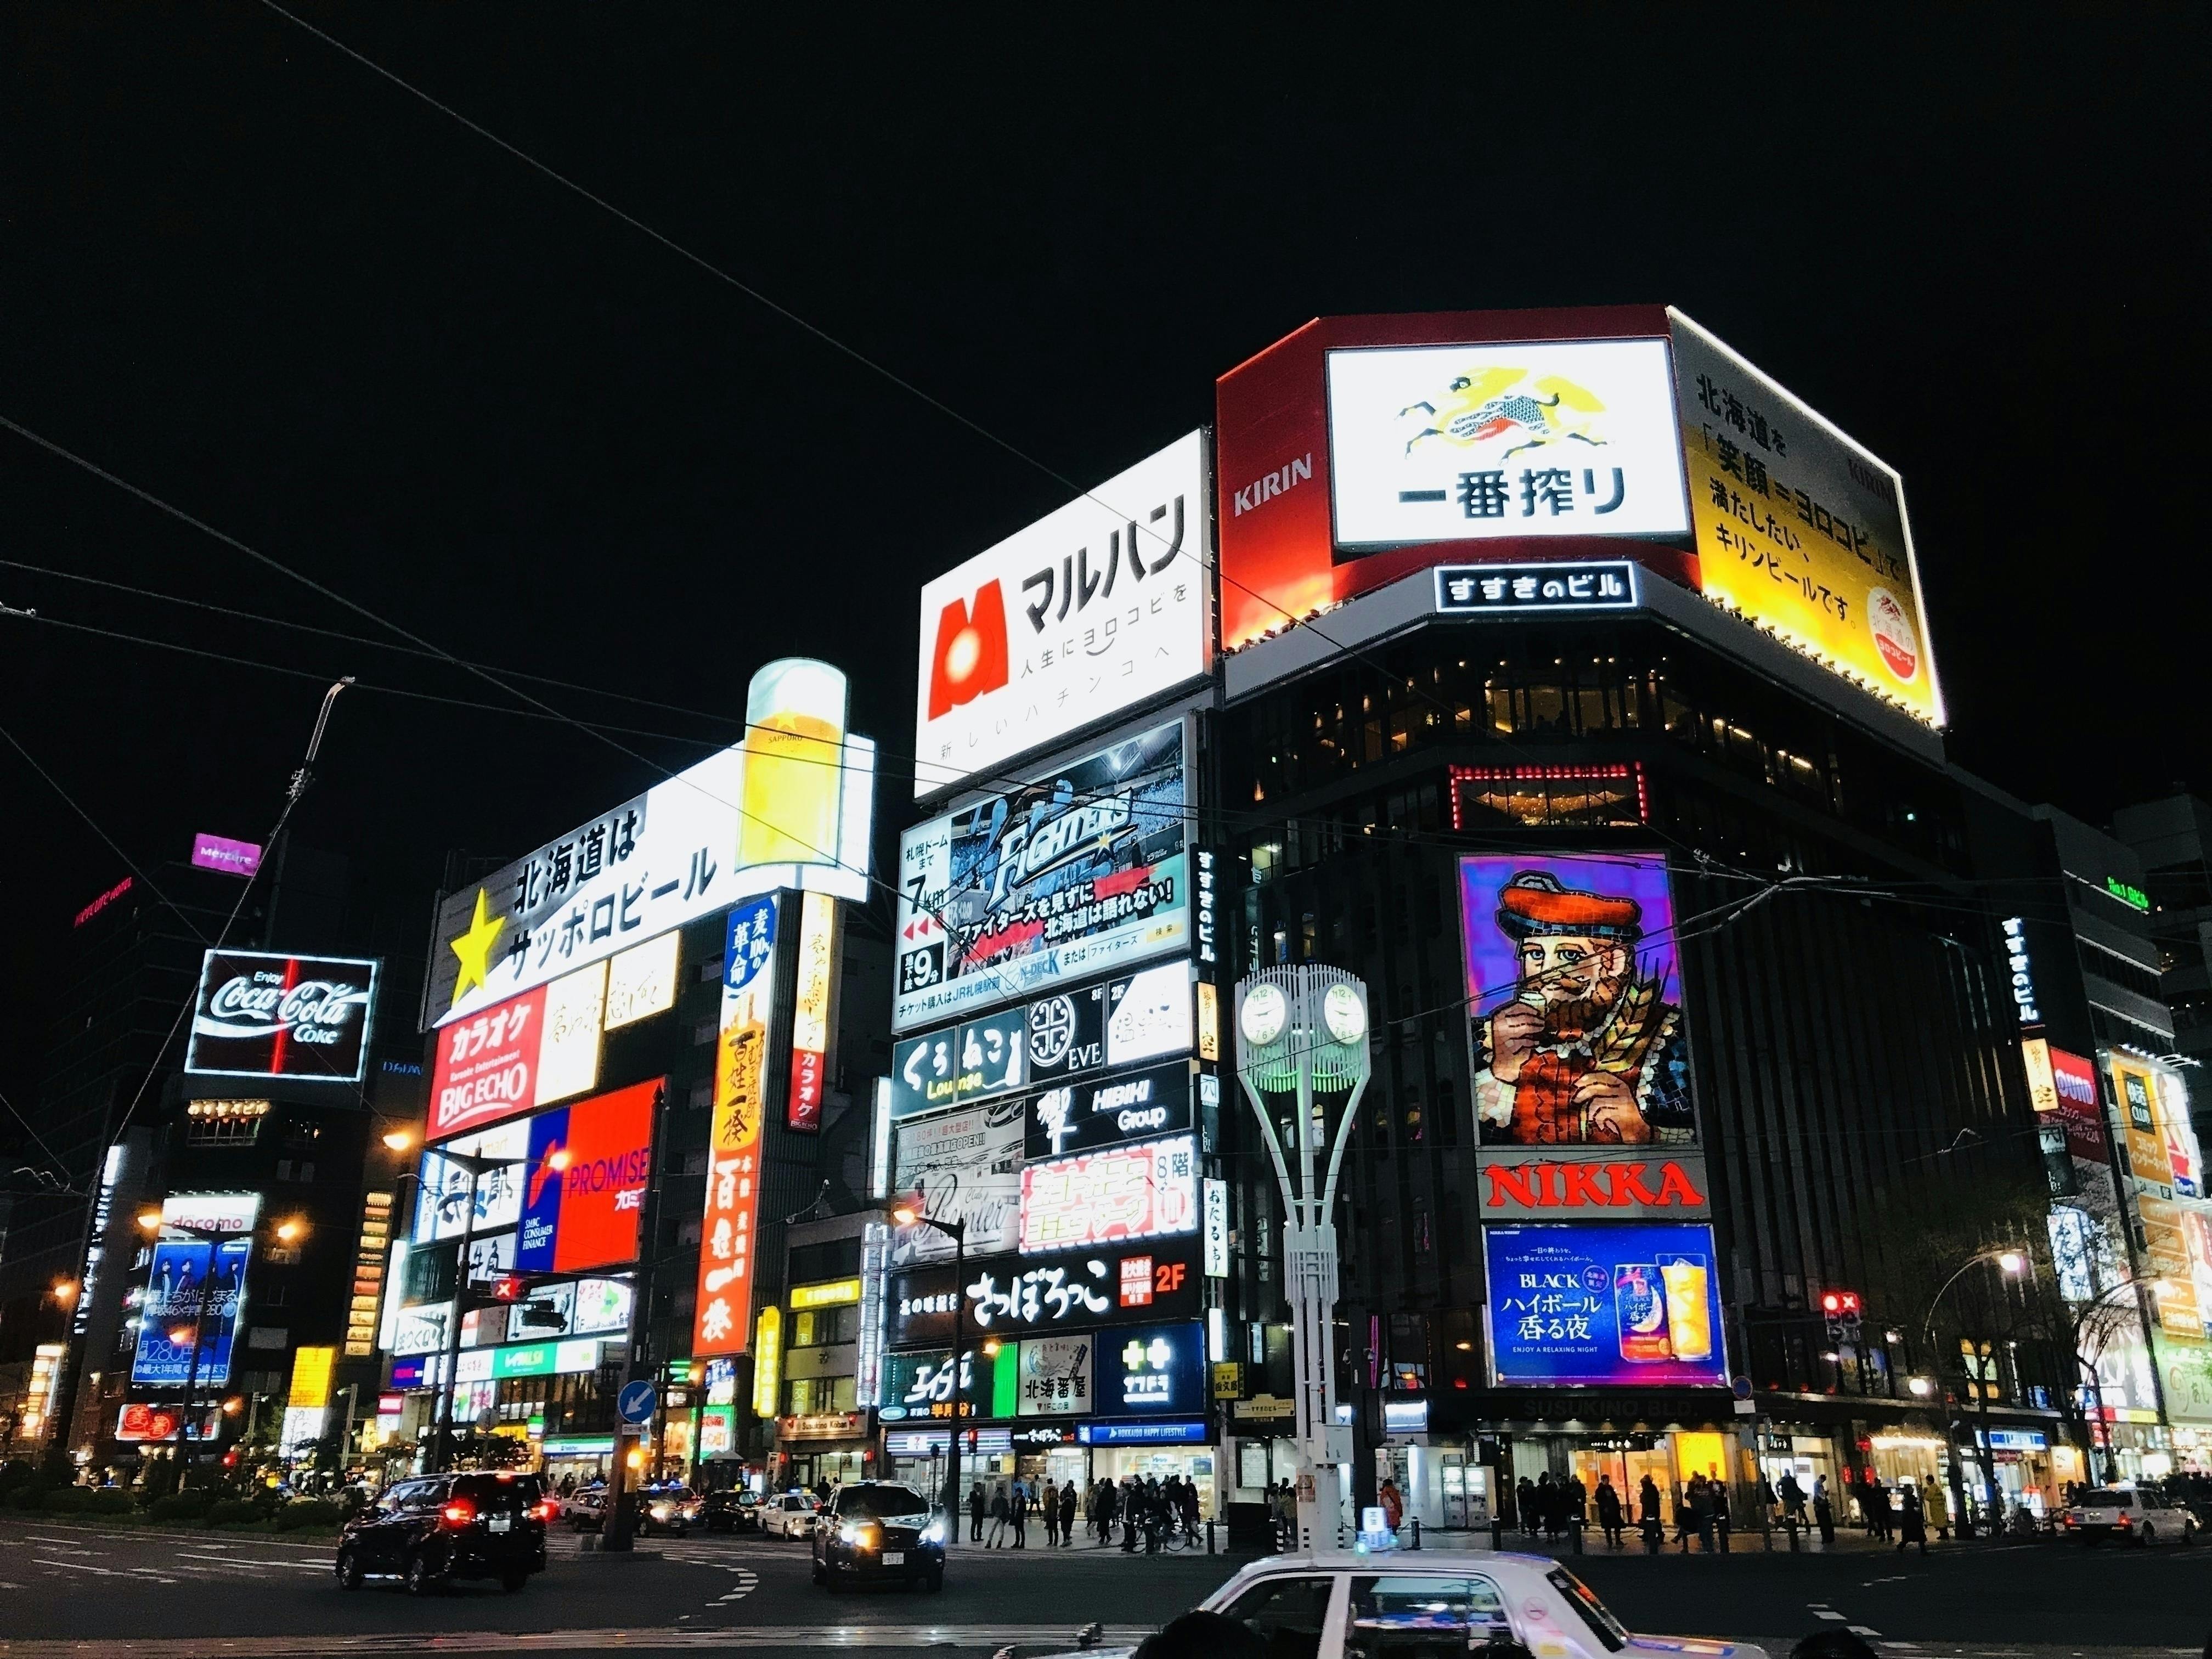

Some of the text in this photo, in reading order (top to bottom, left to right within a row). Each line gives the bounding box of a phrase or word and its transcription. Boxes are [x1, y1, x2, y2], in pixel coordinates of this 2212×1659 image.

[1697, 374, 1786, 458] 北海道を
[1234, 453, 1311, 517] KIRIN
[1398, 467, 1624, 519] 一番搾り
[1709, 477, 1809, 562] 満たしたい、
[1022, 494, 1184, 634] マルハン
[1716, 524, 1856, 630] キリンビールです。
[1449, 574, 1622, 600] すすきのビル
[1021, 584, 1186, 679] 人生にヨロコビを
[768, 734, 803, 743] SAPPORO
[200, 847, 252, 865] Mercure
[906, 834, 948, 861] 札幌ドーム
[986, 787, 1132, 912] FIGHTERS
[514, 810, 637, 914] 北海道は
[919, 855, 934, 870] まで
[509, 847, 718, 981] サッポロビール
[958, 881, 1094, 943] ファイターズを見ずに
[730, 922, 750, 984] 革命
[1064, 947, 1086, 966] または
[1091, 935, 1137, 956] ファイターズ
[254, 971, 285, 985] Enjoy
[2002, 917, 2039, 1021] すすきのビル
[1092, 988, 1102, 1001] 8F
[1111, 984, 1124, 1001] 2F
[294, 1024, 338, 1044] Coke
[449, 1004, 531, 1064] カラオケ
[475, 1049, 521, 1074] Entertainment
[904, 1028, 1003, 1091] くろねこ
[1068, 1043, 1102, 1070] EVE
[438, 1062, 528, 1127] BIG ECHO
[798, 1052, 816, 1116] カラオケ
[927, 1073, 982, 1100] Lounge
[1092, 1079, 1150, 1111] HIBIKI
[1118, 1107, 1166, 1131] Group
[568, 1147, 649, 1198] PROMISE
[1158, 1152, 1188, 1179] 8階
[1483, 1161, 1704, 1207] NIKKA
[173, 1215, 242, 1230] docomo
[524, 1224, 553, 1239] CONSUMER
[525, 1216, 540, 1229] SMBC
[523, 1237, 546, 1250] FINANCE
[1156, 1263, 1185, 1292] 2F
[1520, 1274, 1581, 1288] BLACK
[966, 1260, 1110, 1326] さっぽろっこ
[1501, 1294, 1602, 1313] ハイボール
[1517, 1314, 1592, 1340] 香る夜
[1025, 1375, 1086, 1399] 北海番屋
[1525, 1400, 1639, 1416] SUSUKINO
[1118, 1426, 1186, 1437] HOKKAIDO HAPPY LIFESTYLE
